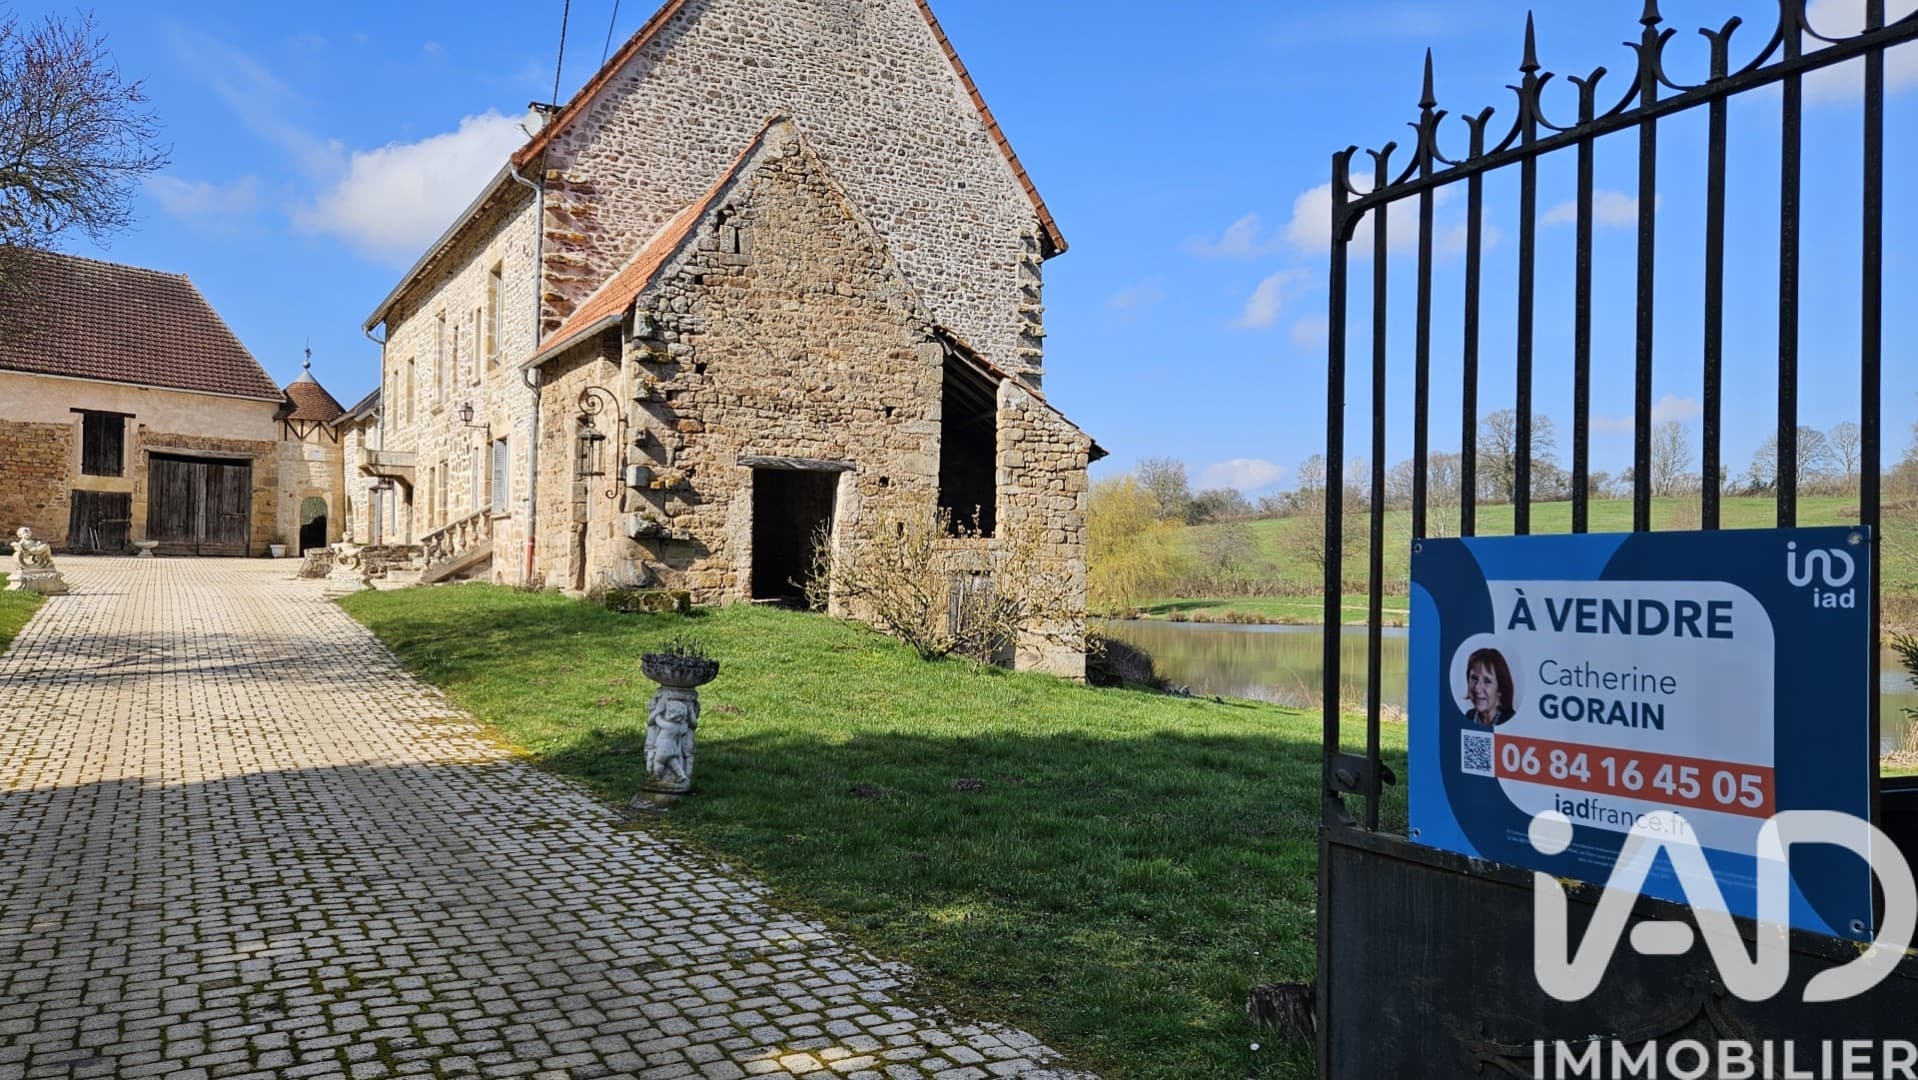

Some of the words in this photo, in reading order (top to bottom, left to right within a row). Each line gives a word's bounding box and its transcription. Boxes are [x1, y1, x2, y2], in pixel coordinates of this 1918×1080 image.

[1507, 588, 1537, 632] À
[1544, 597, 1734, 640] VENDRE
[1813, 587, 1855, 609] iad
[1538, 659, 1677, 696] Catherine
[1538, 693, 1665, 731] GORAIN
[1501, 743, 1541, 776] 06
[1549, 749, 1591, 783] 84
[1600, 756, 1644, 791] 16
[1652, 764, 1701, 799] 45
[1711, 770, 1764, 809] 05
